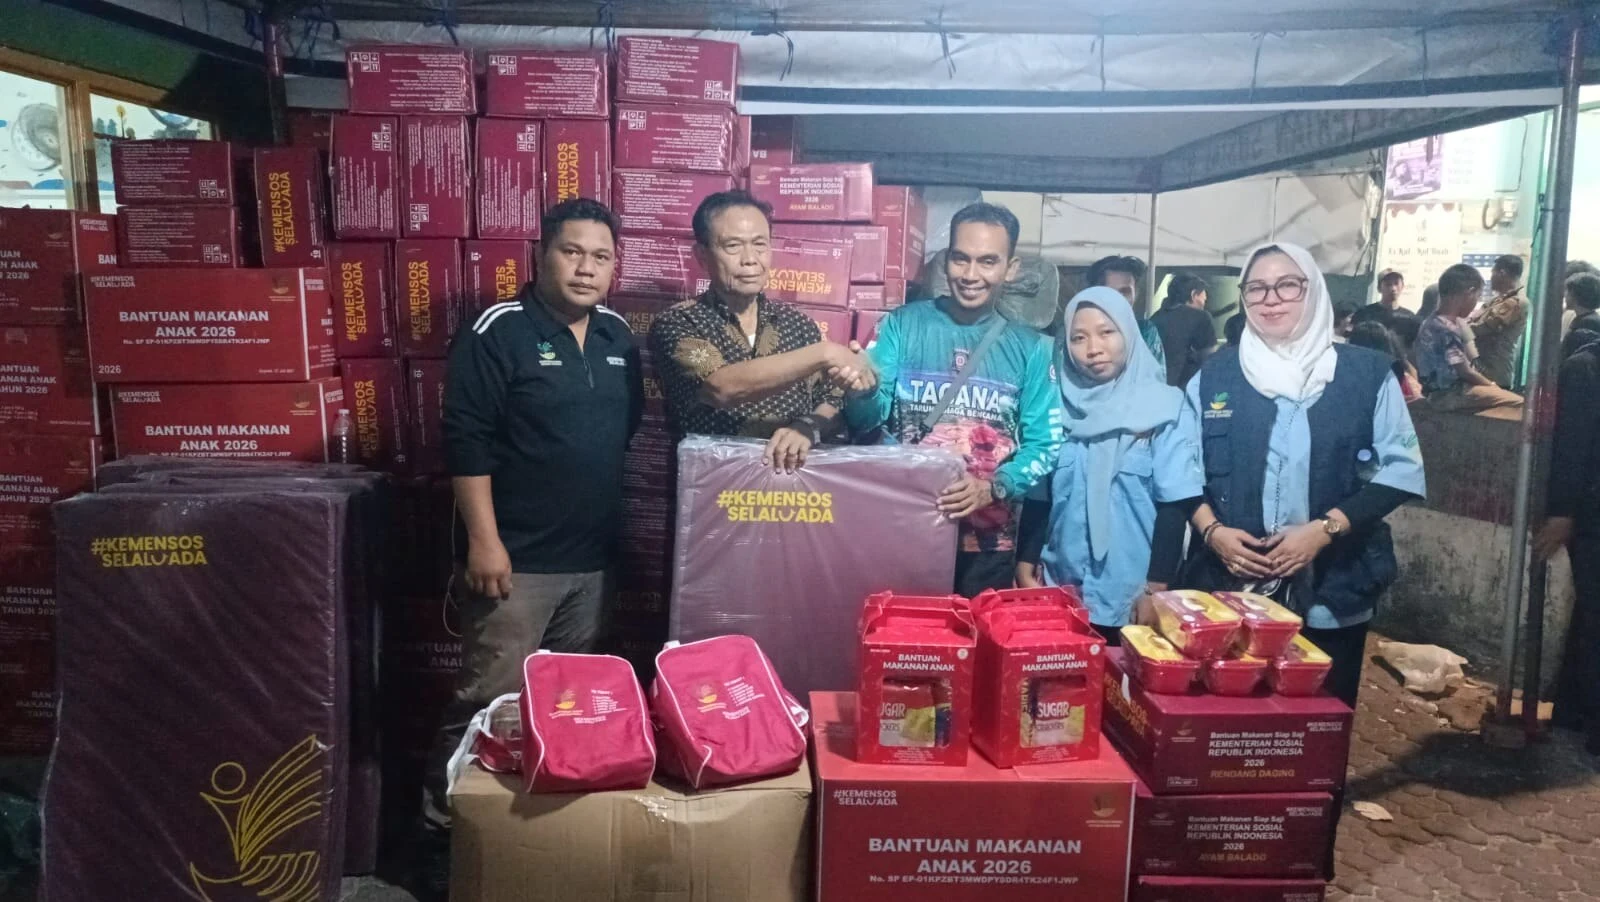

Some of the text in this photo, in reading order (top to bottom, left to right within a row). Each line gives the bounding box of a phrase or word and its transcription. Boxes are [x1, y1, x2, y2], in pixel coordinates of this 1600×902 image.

[269, 172, 286, 253] #KEMENSOS
[11, 261, 38, 269] ANAK
[342, 262, 358, 341] #KEMENSOS
[408, 261, 422, 341] #KEMENSOS
[120, 310, 268, 322] BANTUAN MAKANAN
[156, 326, 236, 337] ANAK 2026
[98, 365, 122, 374] 2026
[30, 376, 56, 384] ANAK
[25, 386, 48, 394] 2026
[145, 424, 290, 436] BANTUAN MAKANAN
[180, 440, 258, 450] ANAK 2026
[716, 490, 832, 508] #KEMENSOS
[90, 535, 204, 555] #KEMENSOS
[898, 654, 940, 662] BANTUAN
[1036, 653, 1075, 662] BANTUAN
[883, 662, 955, 672] MAKANAN ANAK
[1022, 660, 1088, 672] MAKANAN ANAK
[1037, 701, 1070, 718] SUGAR
[1274, 732, 1291, 740] Siap
[1292, 732, 1305, 740] Saji
[1209, 739, 1304, 748] KEMENTERIAN SOSIAL
[1208, 748, 1303, 756] REPUBLIK INDONESIA
[1244, 759, 1265, 767] 2026
[1210, 770, 1256, 778] RENDANG
[833, 789, 897, 799] #KEMENSOS
[1187, 824, 1250, 832] KEMENTERIAN
[1187, 832, 1283, 840] REPUBLIK INDONESIA
[868, 838, 1082, 854] BANTUAN MAKANAN
[1200, 853, 1266, 861] AYAM BALADO
[917, 859, 1032, 874] ANAK 2026
